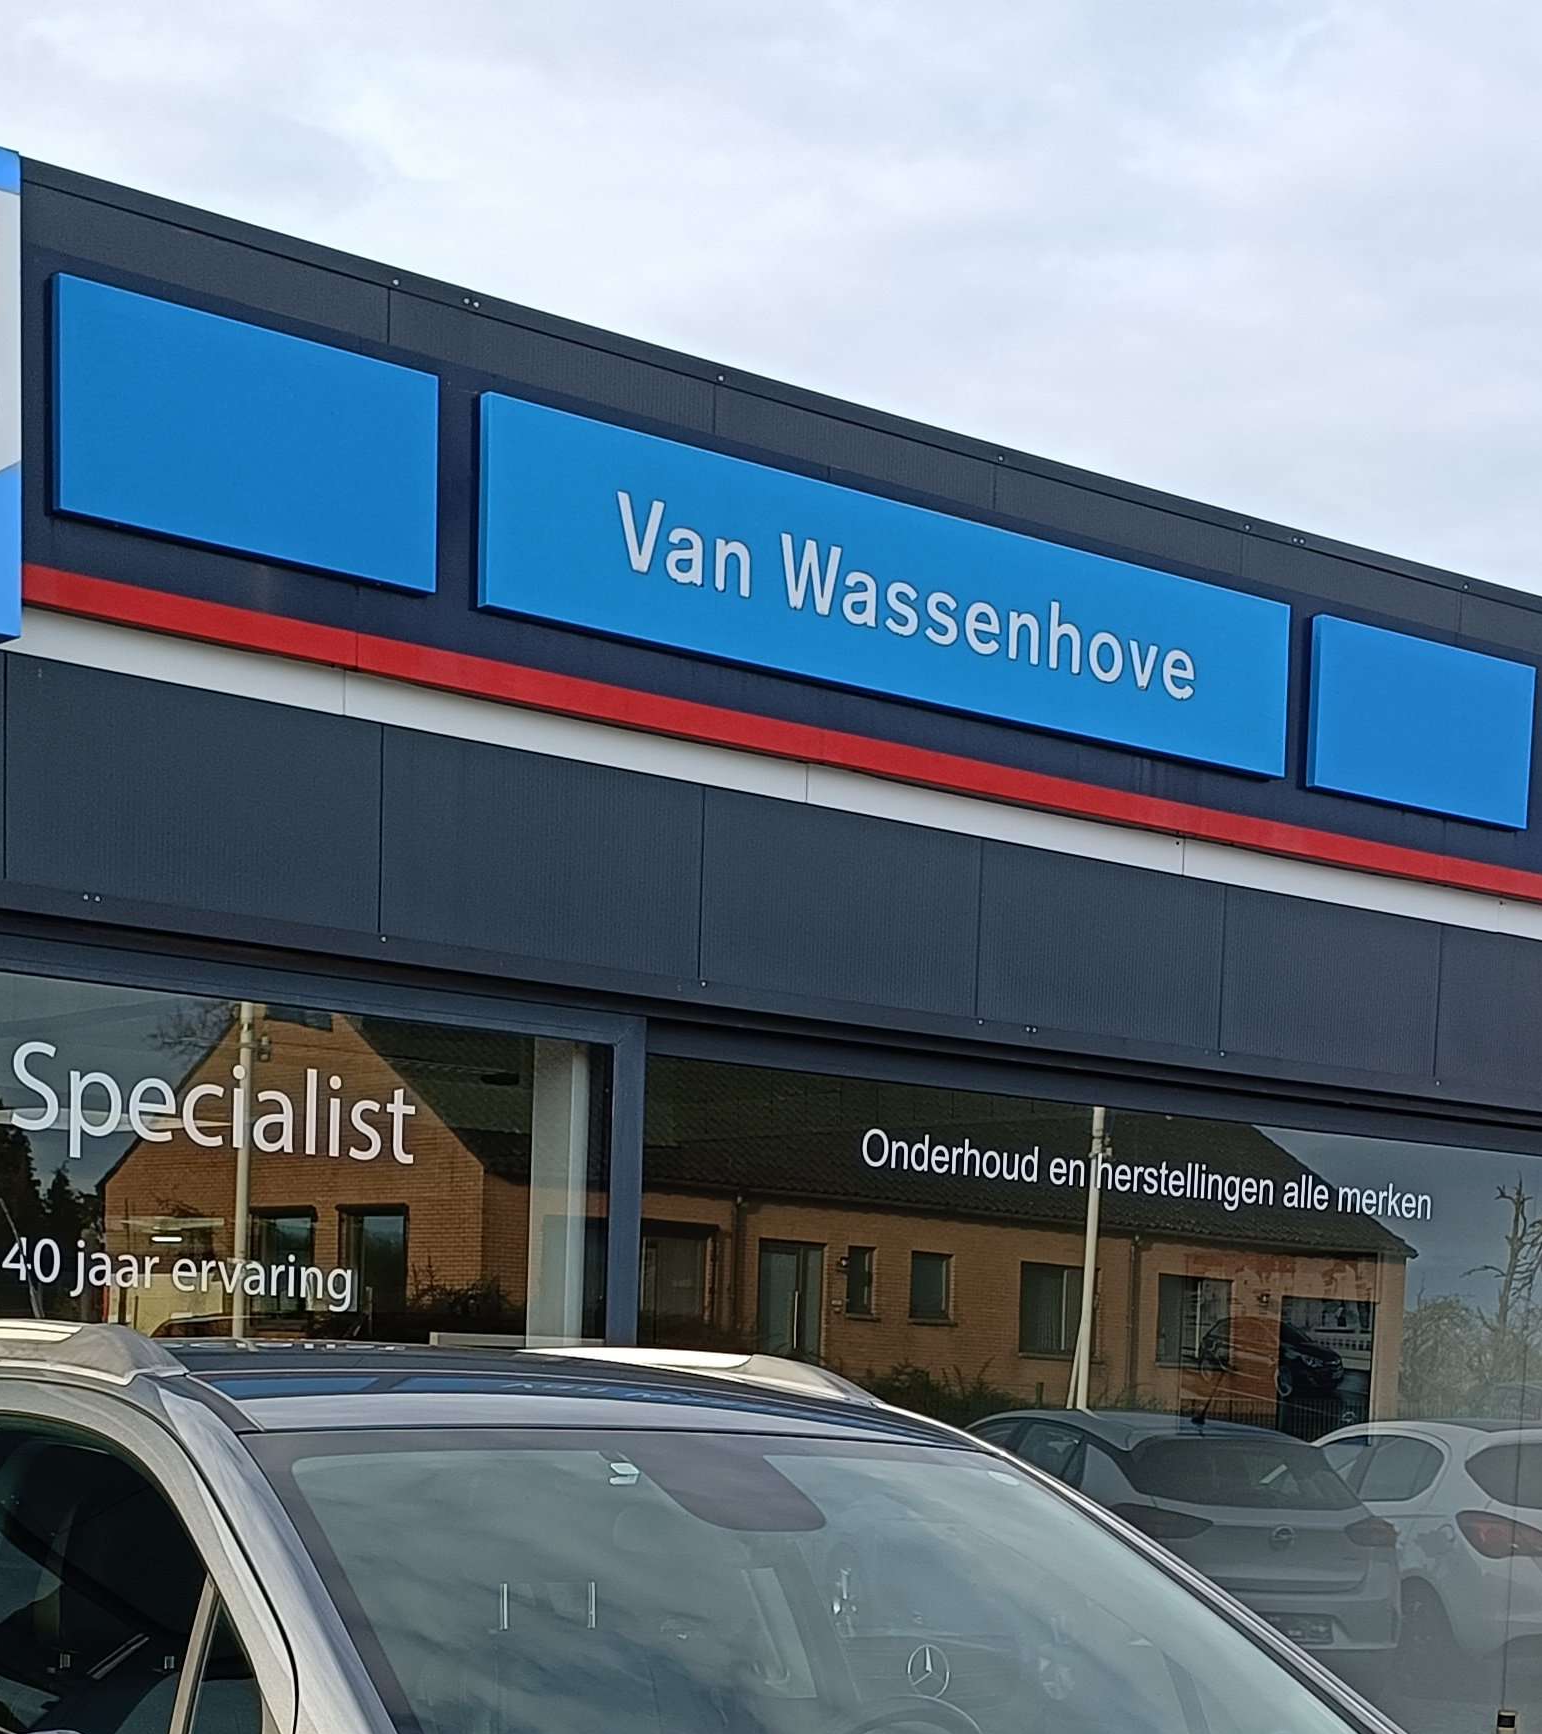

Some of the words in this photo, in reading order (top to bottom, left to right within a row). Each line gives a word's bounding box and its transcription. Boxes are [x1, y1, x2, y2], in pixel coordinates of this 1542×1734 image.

[616, 490, 752, 599] Van
[780, 532, 1197, 702] Wassenhove
[10, 1040, 417, 1165] Specialist
[861, 1127, 1039, 1183] Onderhoud
[1049, 1156, 1085, 1188] en
[1096, 1152, 1274, 1212] herstellingen
[1282, 1174, 1329, 1212] alle
[1337, 1182, 1433, 1221] merken
[1, 1236, 61, 1284] 40
[69, 1239, 160, 1298] jaar
[171, 1253, 355, 1313] ervaring
